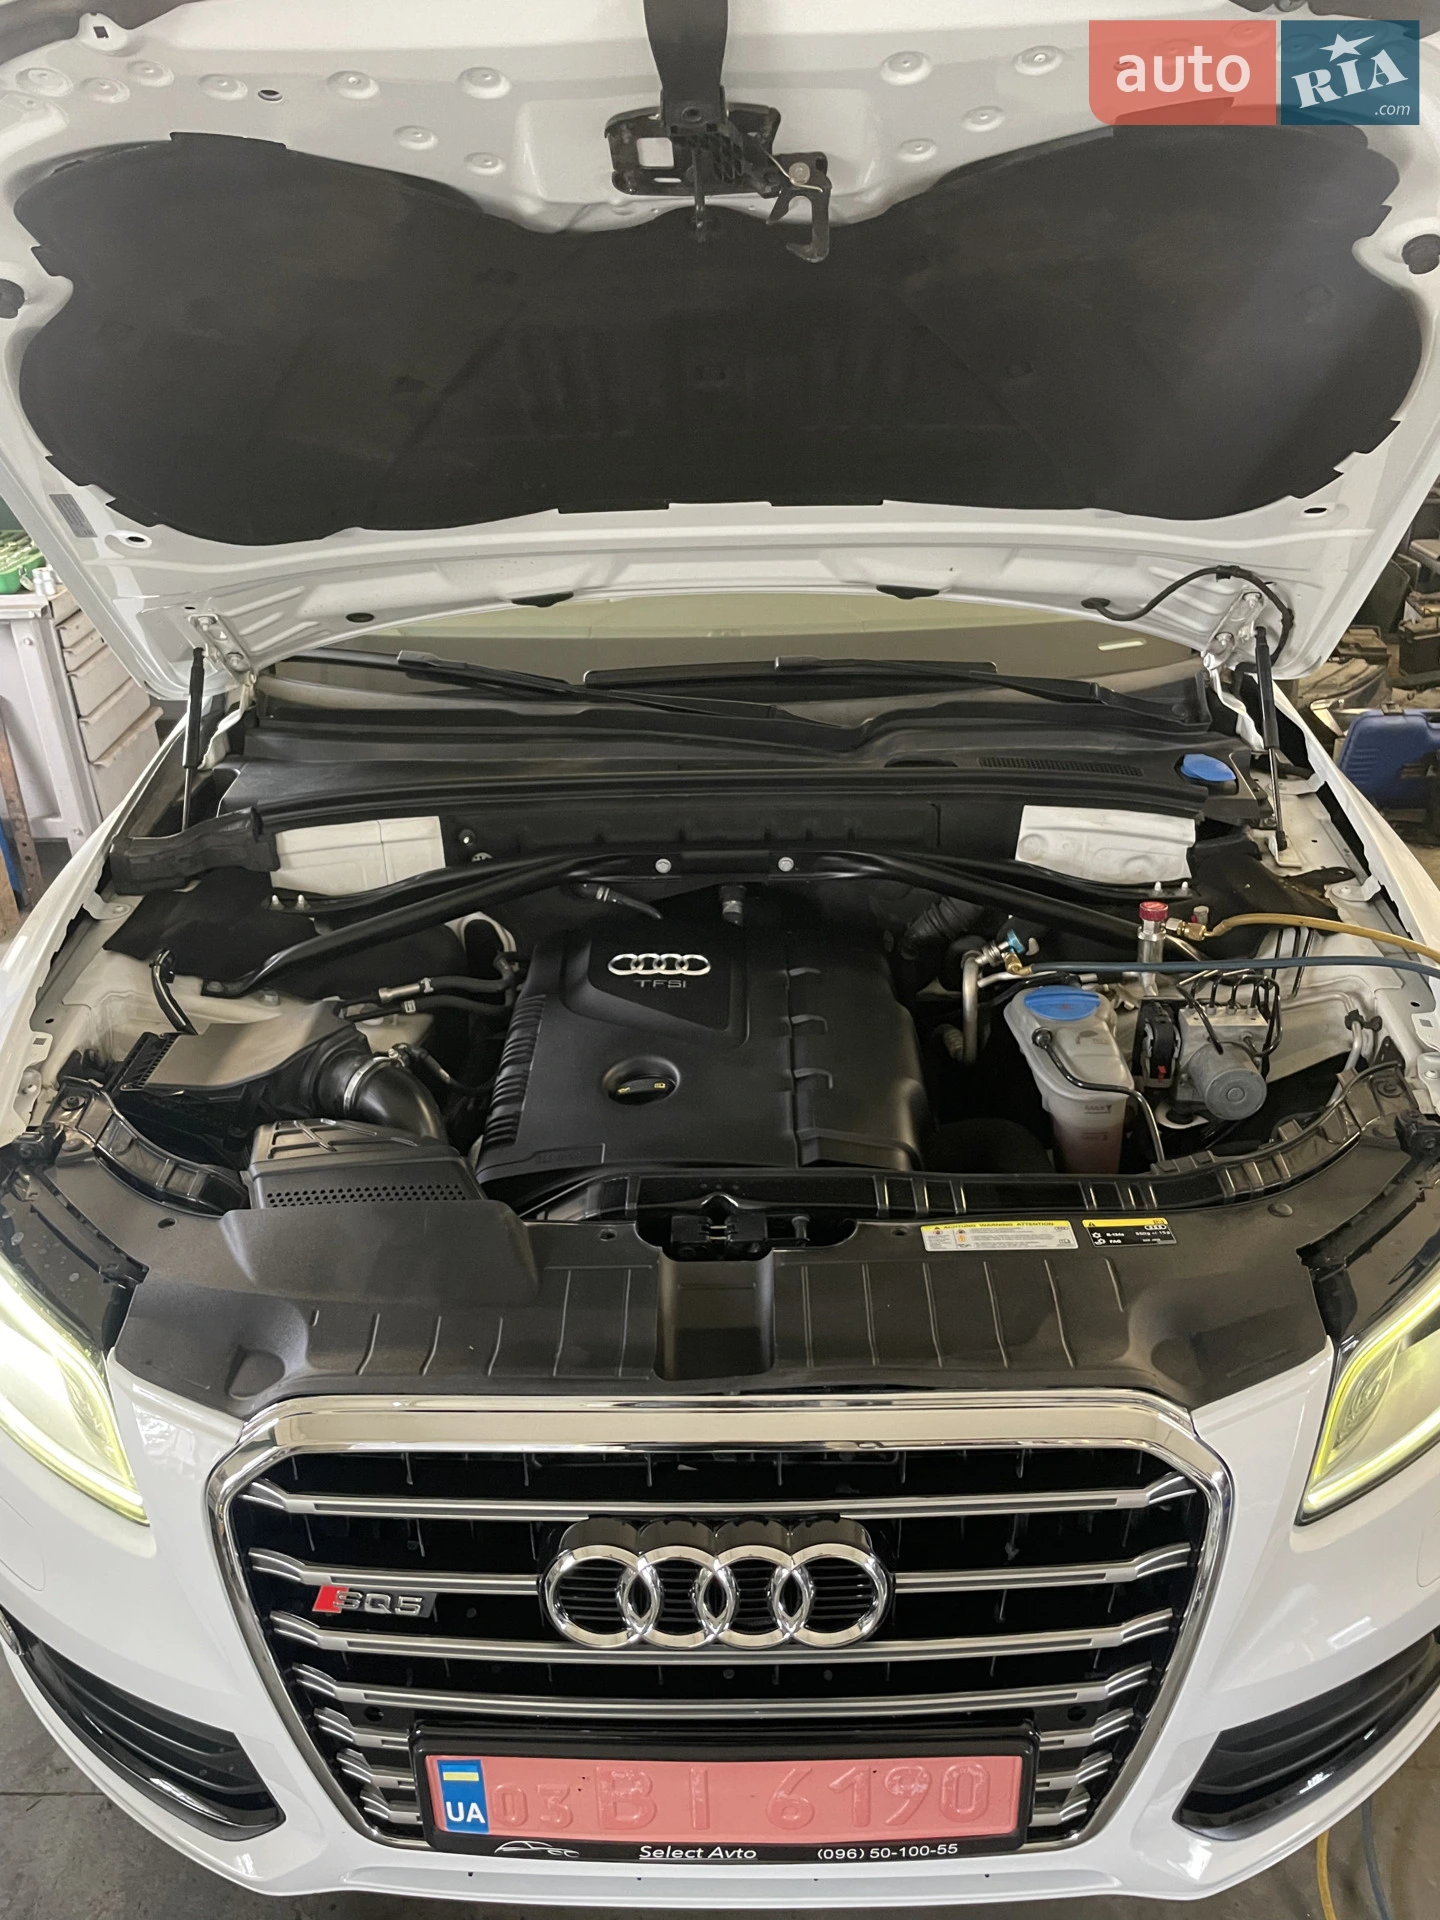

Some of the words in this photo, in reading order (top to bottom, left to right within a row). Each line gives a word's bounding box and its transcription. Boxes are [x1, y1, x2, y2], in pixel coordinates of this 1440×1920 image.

[634, 980, 686, 988] TFSI
[333, 1590, 422, 1615] SQ5
[491, 1783, 573, 1830] 03
[766, 1763, 990, 1831] 6190
[445, 1801, 486, 1824] UA
[639, 1845, 704, 1859] Select
[707, 1846, 757, 1859] Avto
[817, 1848, 865, 1860] (096)
[869, 1843, 958, 1859] 50-100-55
